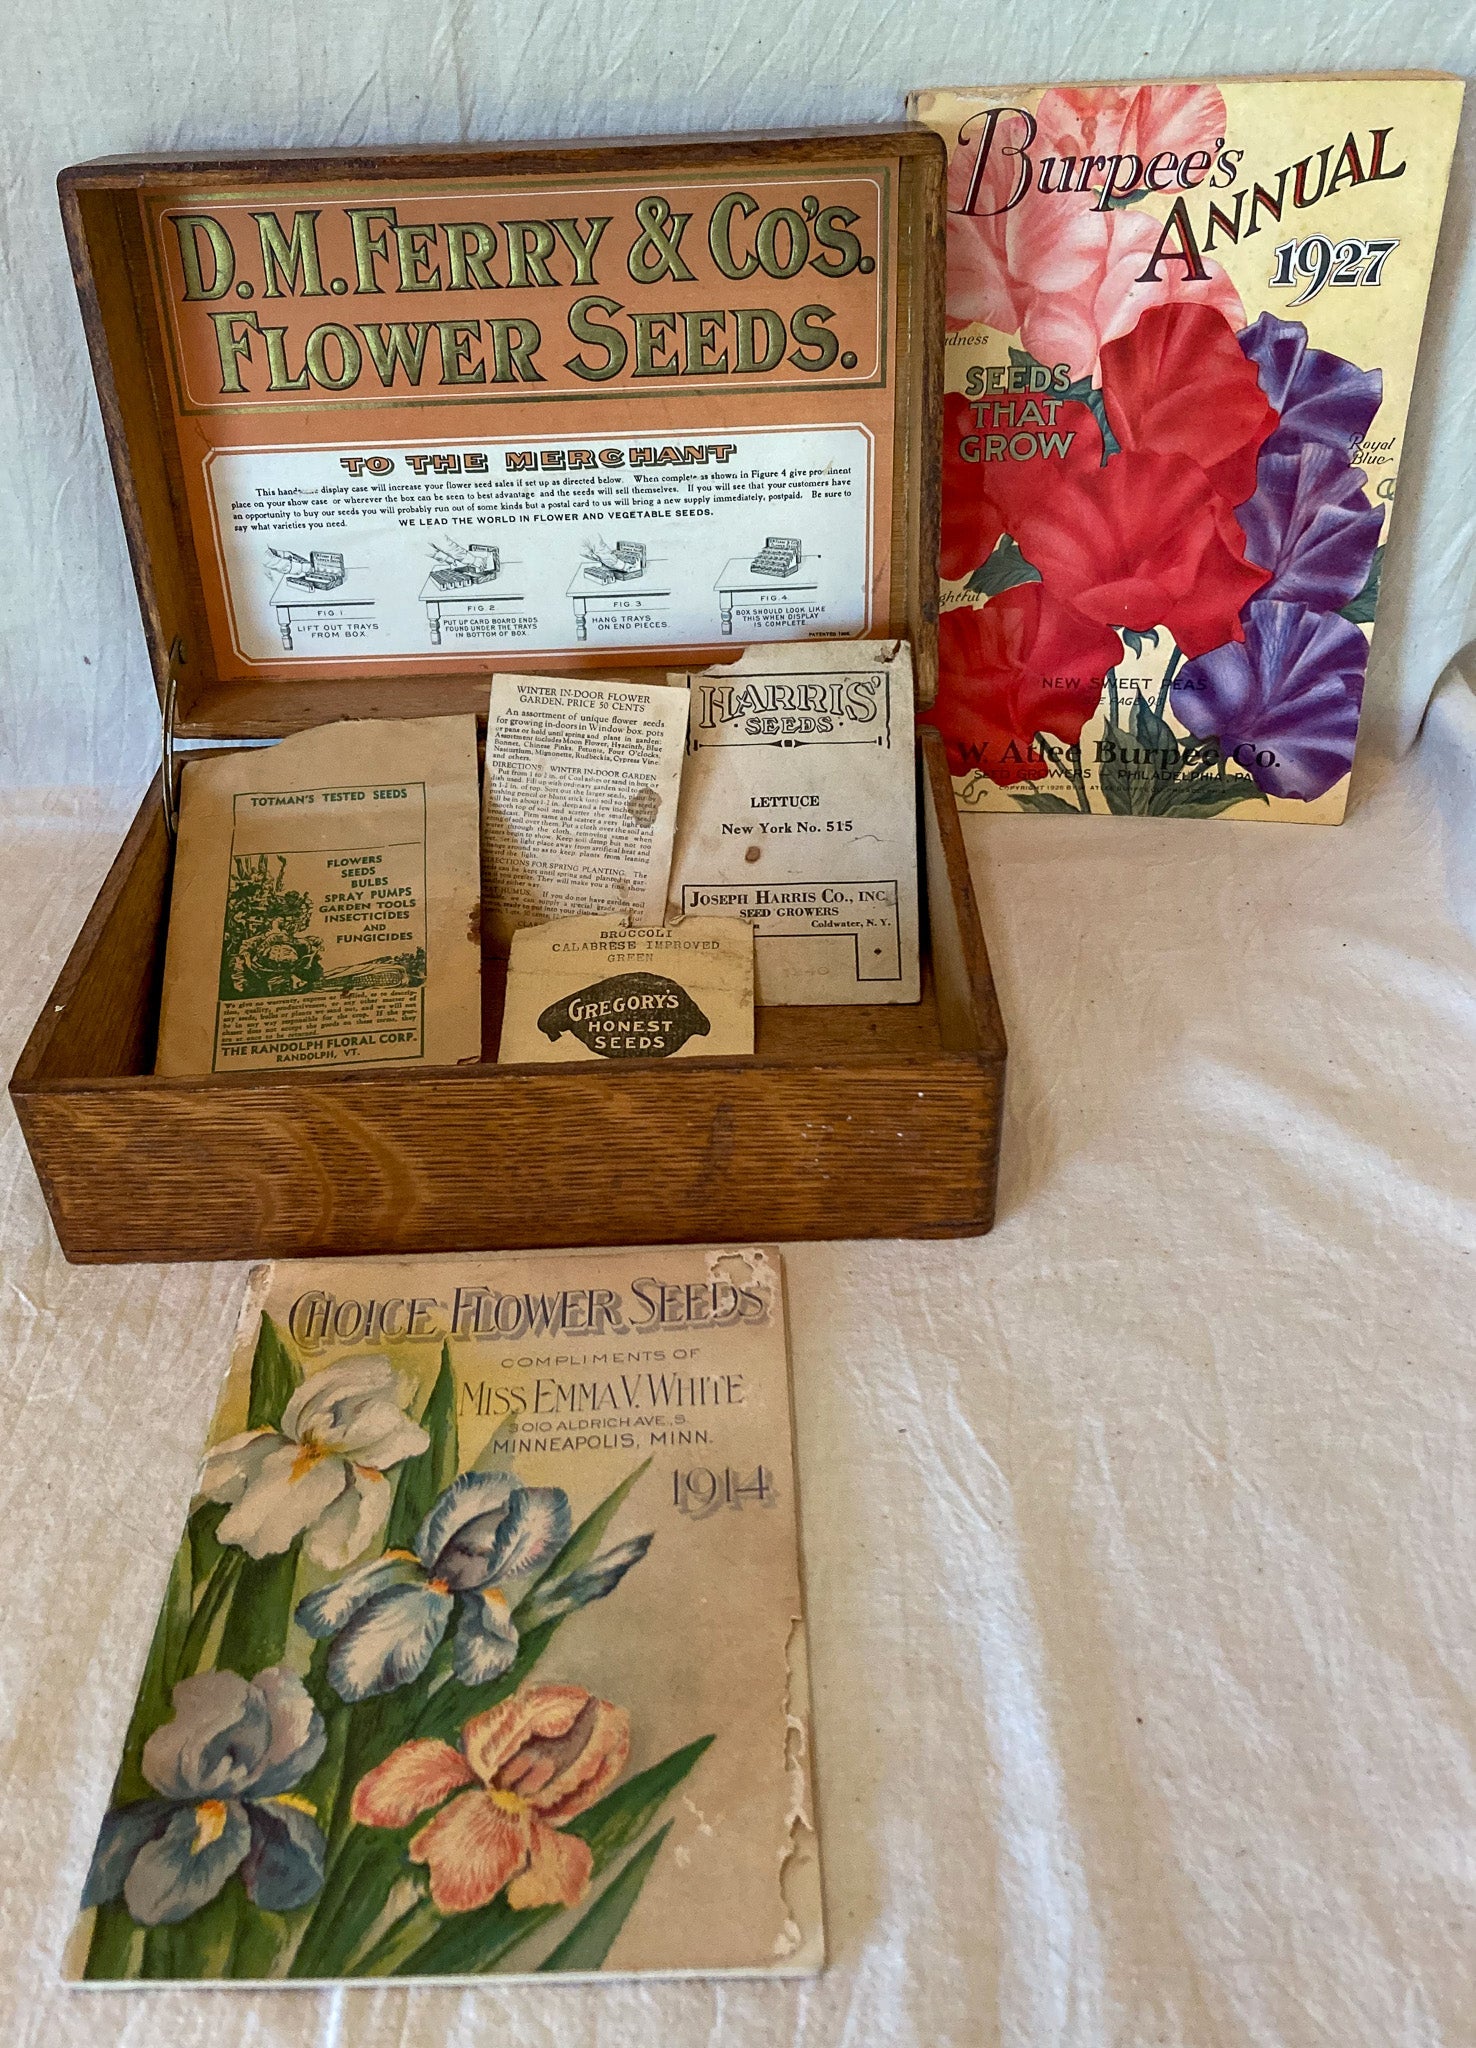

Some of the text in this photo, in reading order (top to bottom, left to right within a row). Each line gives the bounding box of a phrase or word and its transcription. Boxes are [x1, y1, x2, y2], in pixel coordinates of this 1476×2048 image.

[949, 107, 1244, 217] Burpee's
[1135, 126, 1407, 283] ANNUAL
[628, 196, 696, 283] &
[1267, 233, 1401, 308] 1927
[209, 311, 546, 394] FLOWER
[965, 363, 1070, 395] SEEDS
[970, 399, 1063, 428] THAT
[959, 432, 1076, 462] GROW
[1348, 432, 1396, 453] Royal
[341, 443, 738, 477] TO THE MERCHANT
[1349, 450, 1393, 465] Blue
[251, 523, 270, 531] what
[273, 521, 306, 530] varieties
[309, 522, 323, 530] you
[326, 520, 347, 528] need.
[420, 518, 448, 526] LEAD
[477, 515, 515, 524] WORLD
[534, 514, 578, 522] FLOWER
[583, 512, 604, 520] AND
[608, 510, 671, 519] VEGETABLE
[675, 509, 713, 517] SEEDS.
[1042, 678, 1207, 690] NEW SWEET PEAS
[517, 685, 650, 703] WINTER IN-DOOR FLOWER
[700, 675, 881, 729] HARRIS'
[520, 695, 645, 712] GARDEN. PRICE 50 CENTS
[505, 708, 665, 728] An assortment of unique flower seeds
[745, 716, 834, 735] SEEDS
[957, 739, 1281, 770] W. Atlee Burpee Co.
[1016, 769, 1091, 782] GROWERS
[251, 789, 407, 807] TOTMAN'S TESTED SEEDS
[751, 796, 820, 808] LETTUCE
[722, 821, 853, 834] New York No. 515
[327, 855, 382, 868] FLOWERS
[341, 867, 375, 878] SEEDS
[352, 877, 388, 888] BULBS
[325, 887, 412, 902] SPRAY PUMPS
[690, 891, 748, 907] JOSEPH
[755, 890, 816, 904] HARRIS
[319, 899, 416, 912] GARDEN TOOLS
[740, 907, 839, 918] SEED GROWERS
[325, 911, 409, 923] INSECTICIDES
[811, 918, 891, 928] Coldwater, N. Y.
[337, 932, 413, 943] FUNGICIDES
[600, 930, 673, 938] BROCCOLI
[552, 940, 720, 952] CALABRESE IMPROVED
[608, 953, 653, 962] GREEN
[568, 989, 679, 1022] GREGORY'S
[588, 1021, 673, 1032] HONEST
[222, 1032, 417, 1056] THE RANDOLPH FLORAL CORP.
[595, 1037, 665, 1049] SEEDS
[277, 1048, 360, 1063] RANDOLPH, VT.
[288, 1277, 767, 1348] CHOICE FLOWER SEEDS
[501, 1349, 700, 1369] COMPLIMENTS OF
[647, 1372, 744, 1407] WHITE
[556, 1417, 630, 1431] ALDRICH
[493, 1431, 714, 1453] MINNEAPOLIS, MINN.
[671, 1464, 774, 1513] 1914
